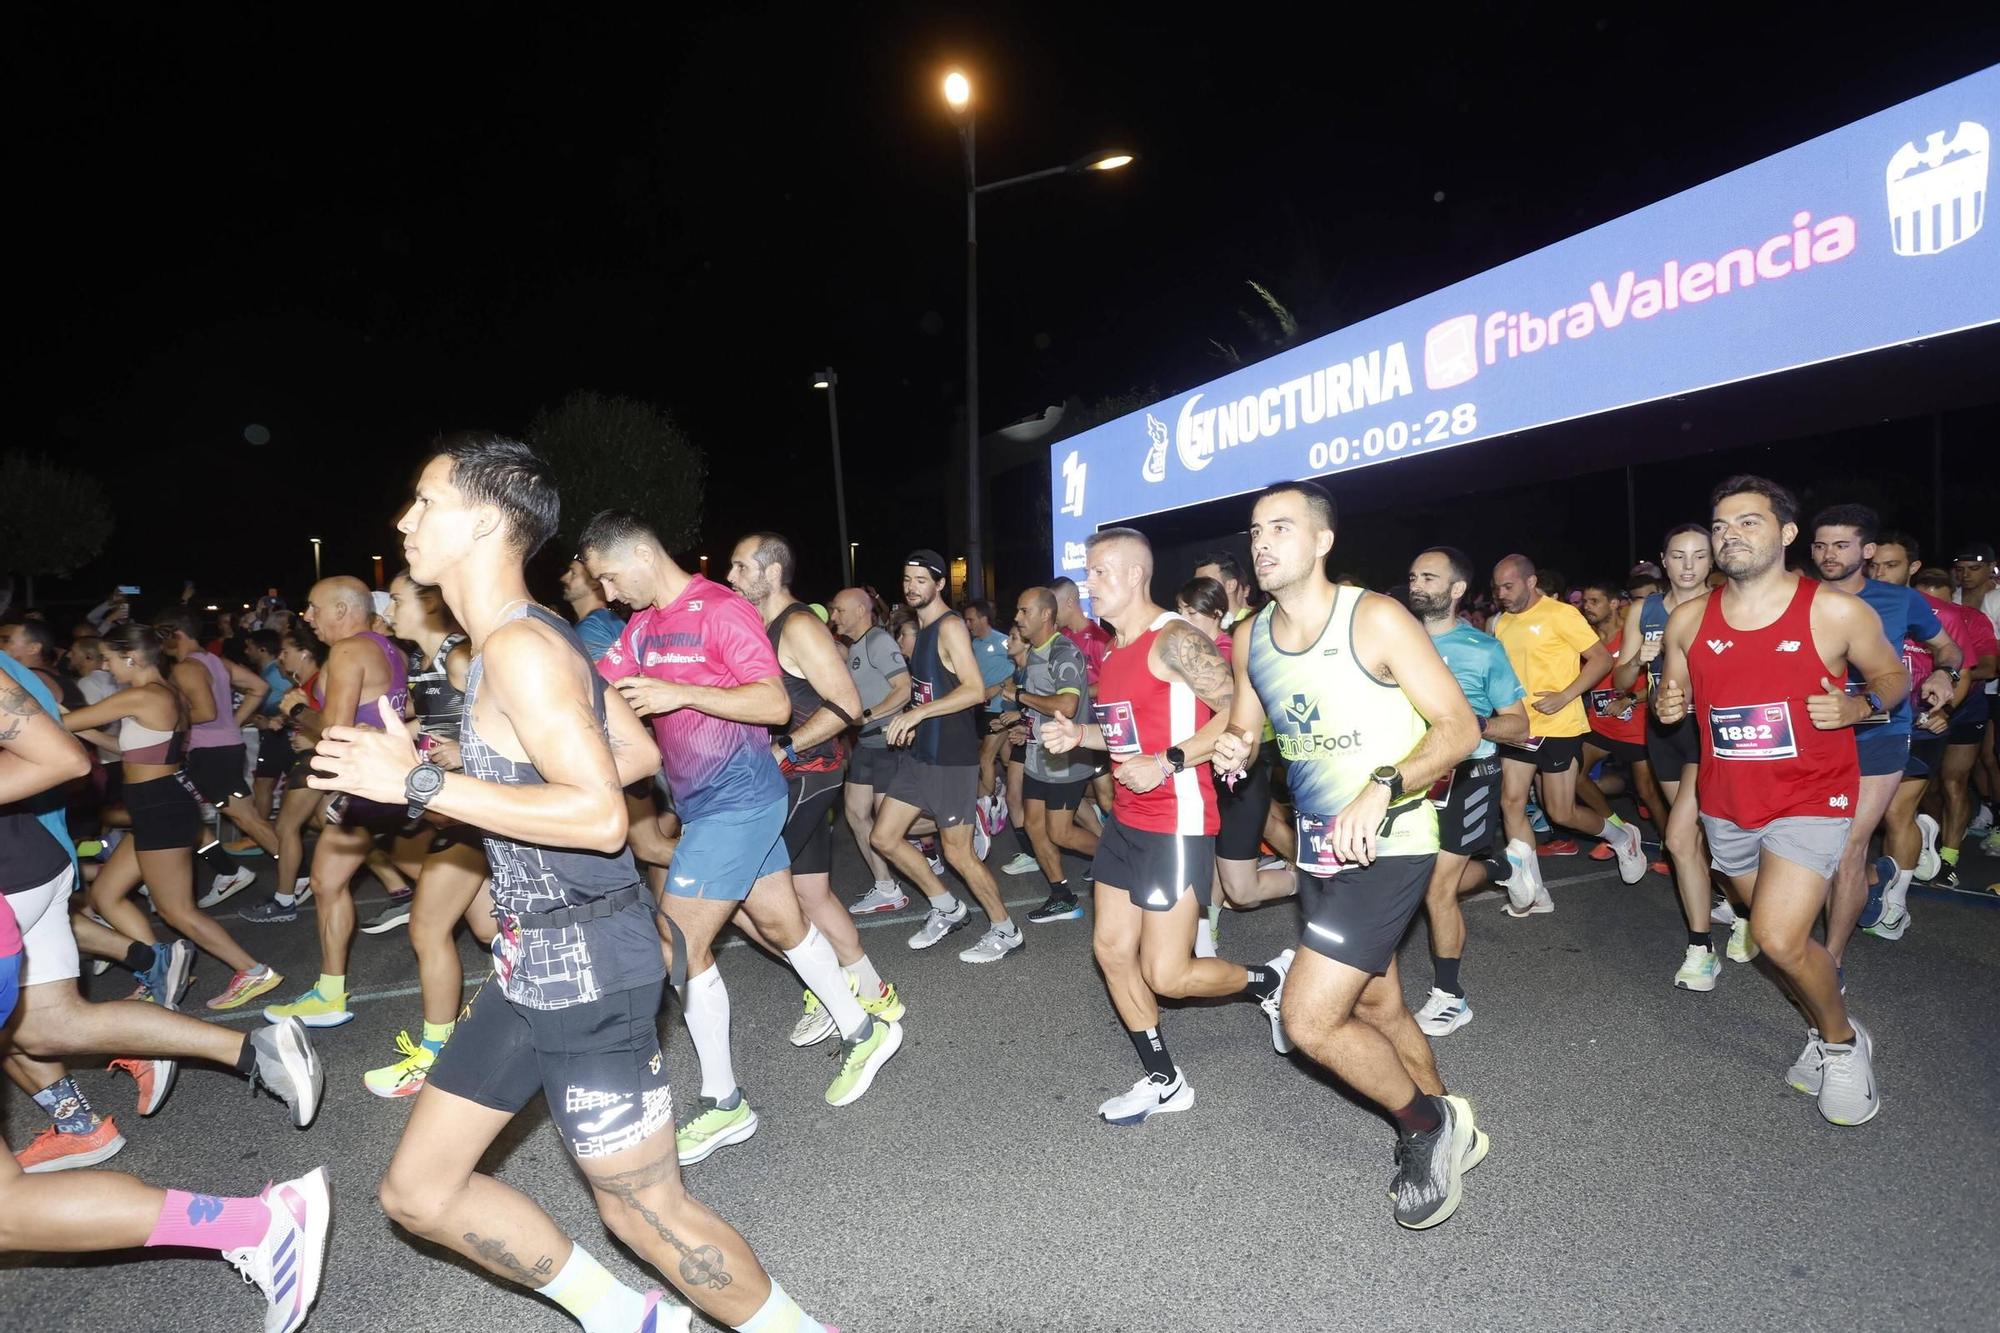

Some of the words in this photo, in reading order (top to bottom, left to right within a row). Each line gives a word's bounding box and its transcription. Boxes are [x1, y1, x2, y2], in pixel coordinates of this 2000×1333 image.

[1485, 211, 1856, 365] fibraValencia
[1217, 341, 1413, 450] NOCTURNA
[1309, 402, 1477, 469] 00:00:28
[1718, 725, 1773, 740] 1882
